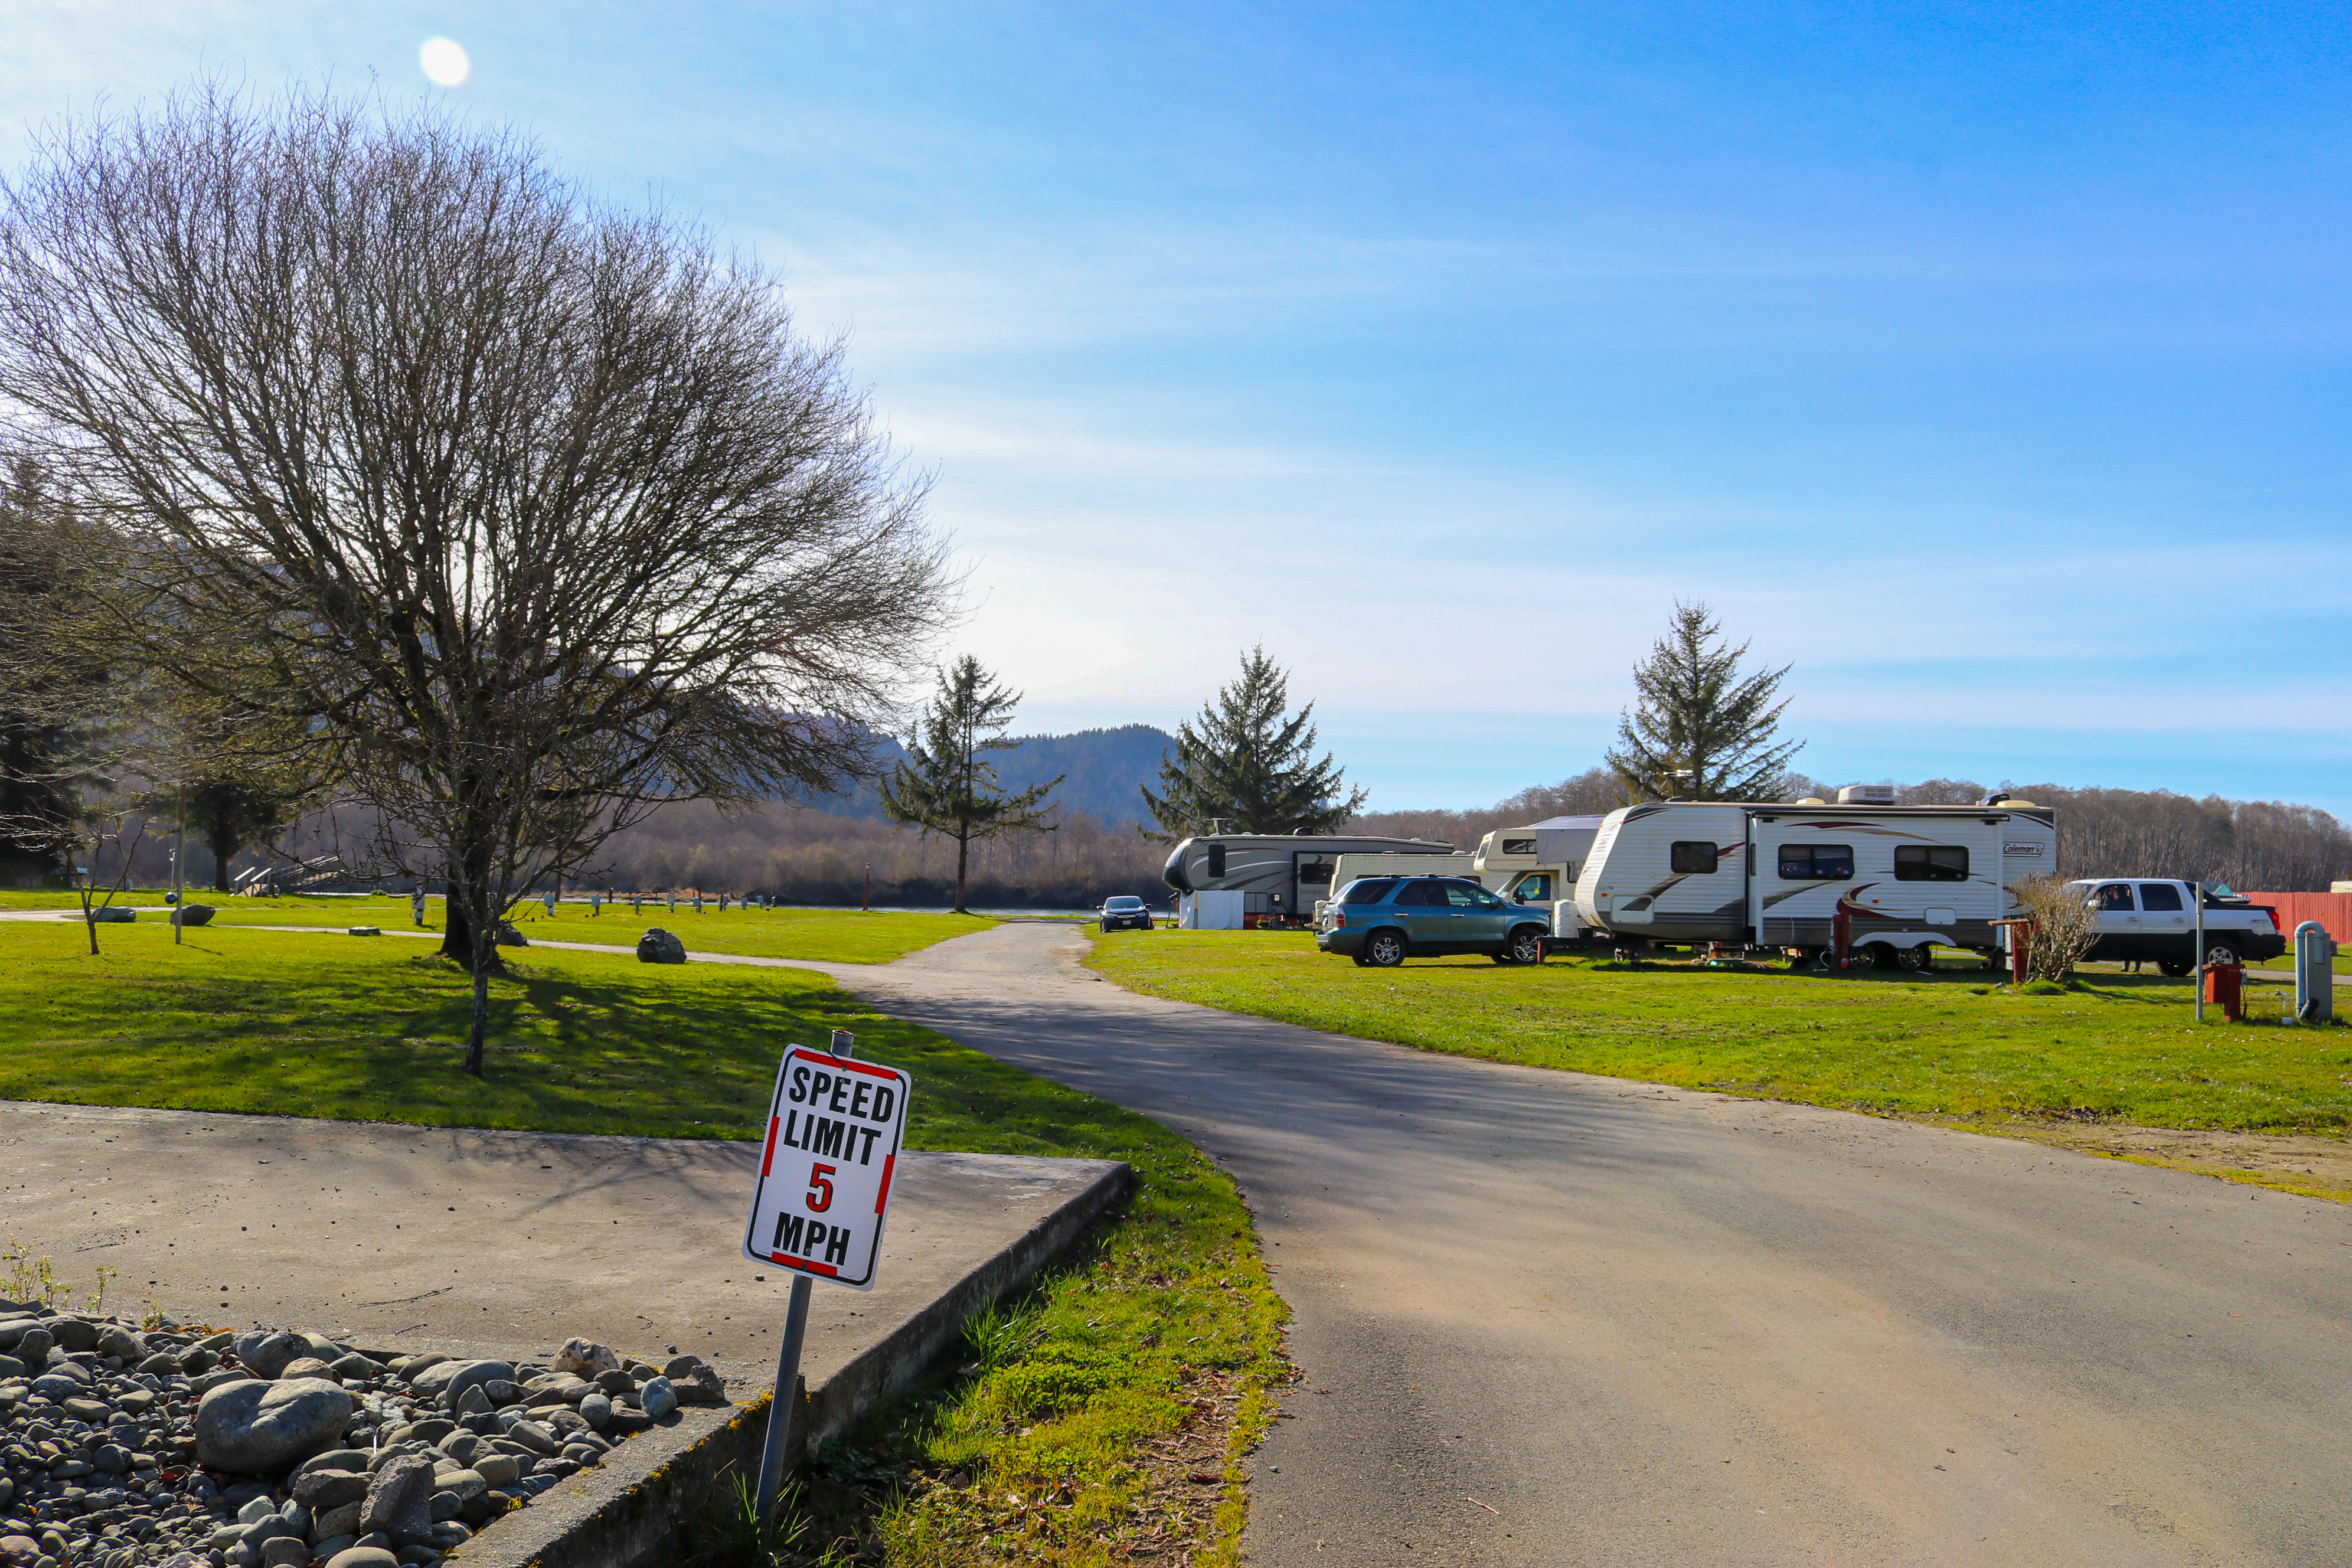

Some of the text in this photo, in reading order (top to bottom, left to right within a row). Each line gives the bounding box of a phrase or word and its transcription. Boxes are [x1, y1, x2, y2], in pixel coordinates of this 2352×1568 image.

[2003, 844, 2034, 852] Coleman
[789, 1066, 894, 1123] SPEED
[783, 1109, 882, 1166] LIMIT
[805, 1162, 837, 1213] 5
[772, 1211, 851, 1266] MPH
